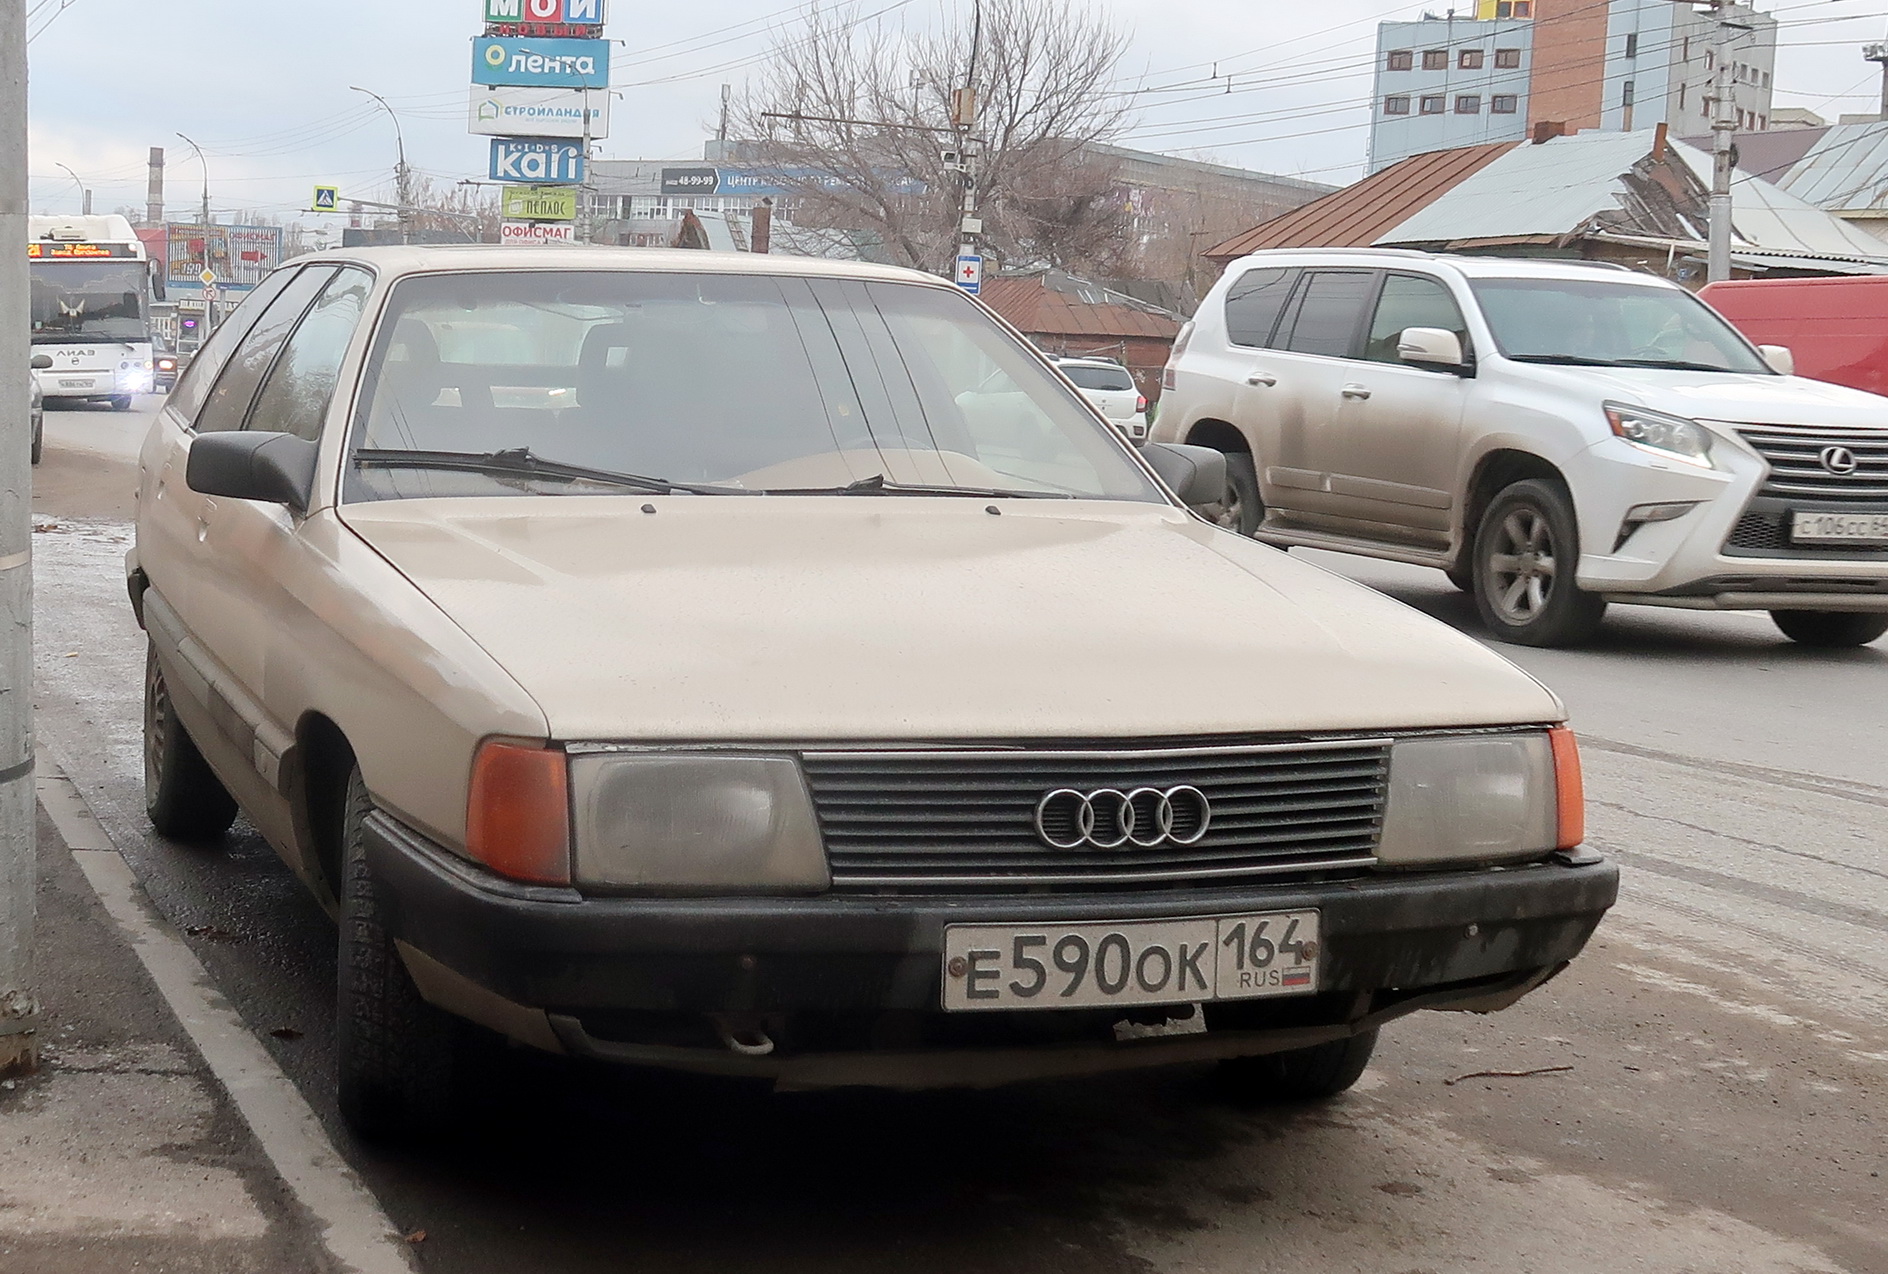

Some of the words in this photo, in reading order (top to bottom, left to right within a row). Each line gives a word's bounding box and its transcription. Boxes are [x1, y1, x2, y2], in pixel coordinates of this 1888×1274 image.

[504, 104, 600, 118] СТРОЙЛАНДЯ
[497, 144, 578, 180] kari
[727, 176, 759, 189] ЦЕНТР
[526, 200, 566, 215] ПЕПЛОС
[502, 226, 572, 239] ОФИСМАГ
[965, 932, 1210, 1000] Е590ОК
[1222, 918, 1304, 971] 164
[1239, 968, 1281, 989] RUS
